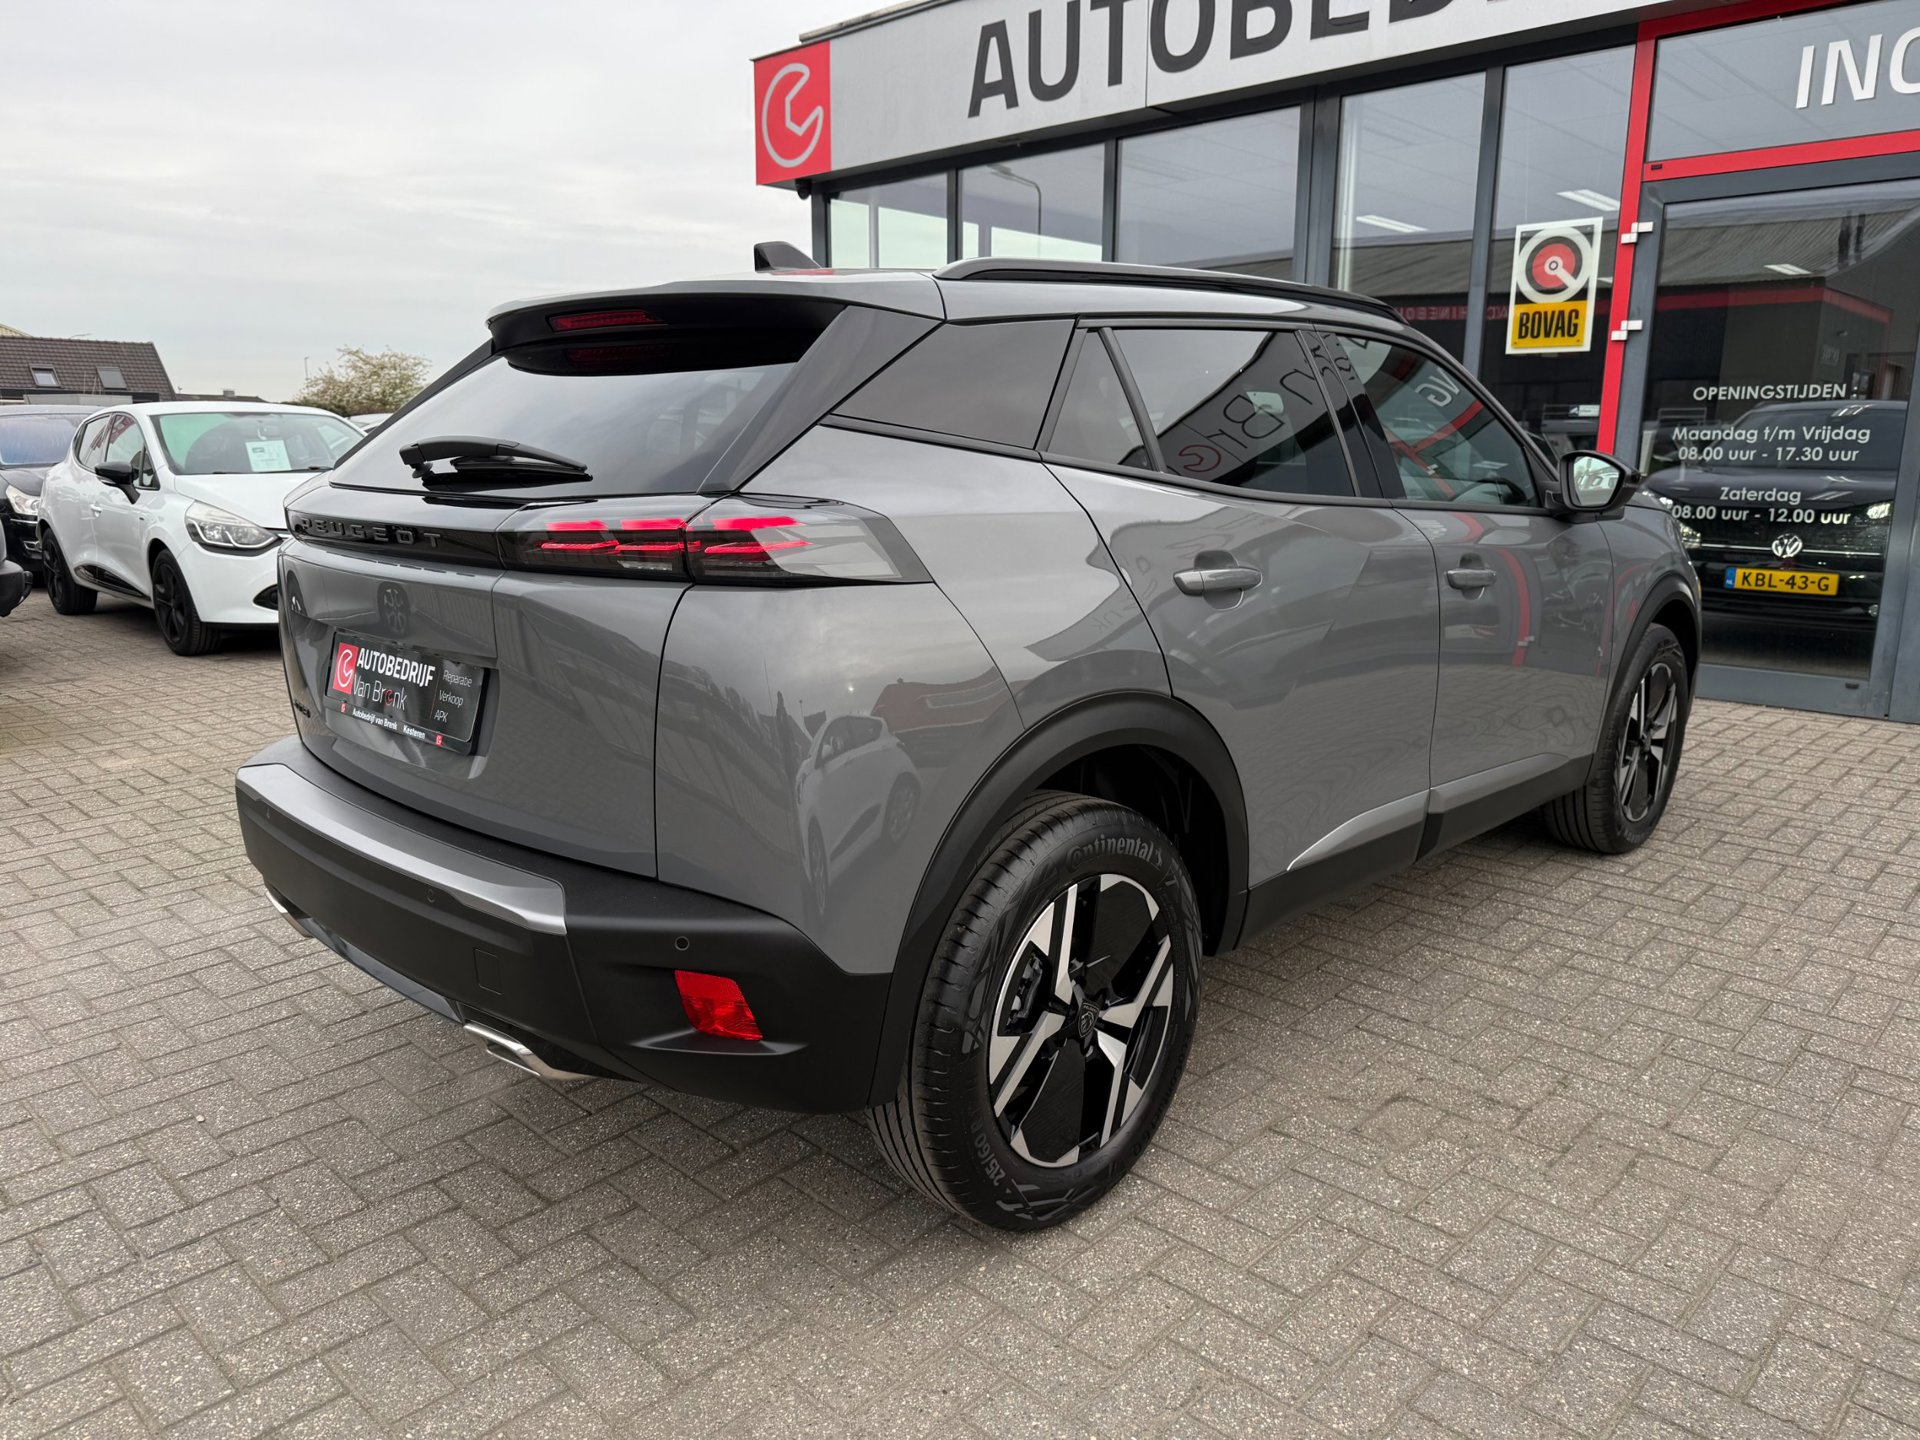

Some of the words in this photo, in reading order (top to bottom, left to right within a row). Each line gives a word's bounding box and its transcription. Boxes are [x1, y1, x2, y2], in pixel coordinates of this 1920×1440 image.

[1518, 308, 1580, 340] BOVAG
[1693, 384, 1846, 401] OPENINGSTIJDEN
[1672, 427, 1758, 443] Maandag
[1763, 427, 1796, 441] t/m
[1803, 426, 1871, 443] Vrijdag
[1678, 447, 1723, 461] 08.00
[1728, 449, 1757, 461] uur
[1776, 447, 1823, 461] 17.30
[1828, 449, 1859, 461] uur
[1720, 487, 1801, 505] Zaterdag
[1671, 506, 1716, 520] 08.00
[1721, 508, 1750, 521] uur
[1769, 508, 1815, 523] 12.00
[1820, 511, 1851, 524] uur
[300, 518, 441, 548] PEUGEOT
[1741, 572, 1830, 591] KBL-43-G
[357, 648, 436, 687] AUTOBEDRIJF
[353, 674, 370, 699] Van
[439, 690, 464, 708] Verkoop
[352, 707, 375, 725] Autobedrijf
[375, 717, 383, 726] van
[403, 724, 426, 739] Kesteren
[434, 709, 448, 723] APK
[1066, 834, 1154, 872] Continental
